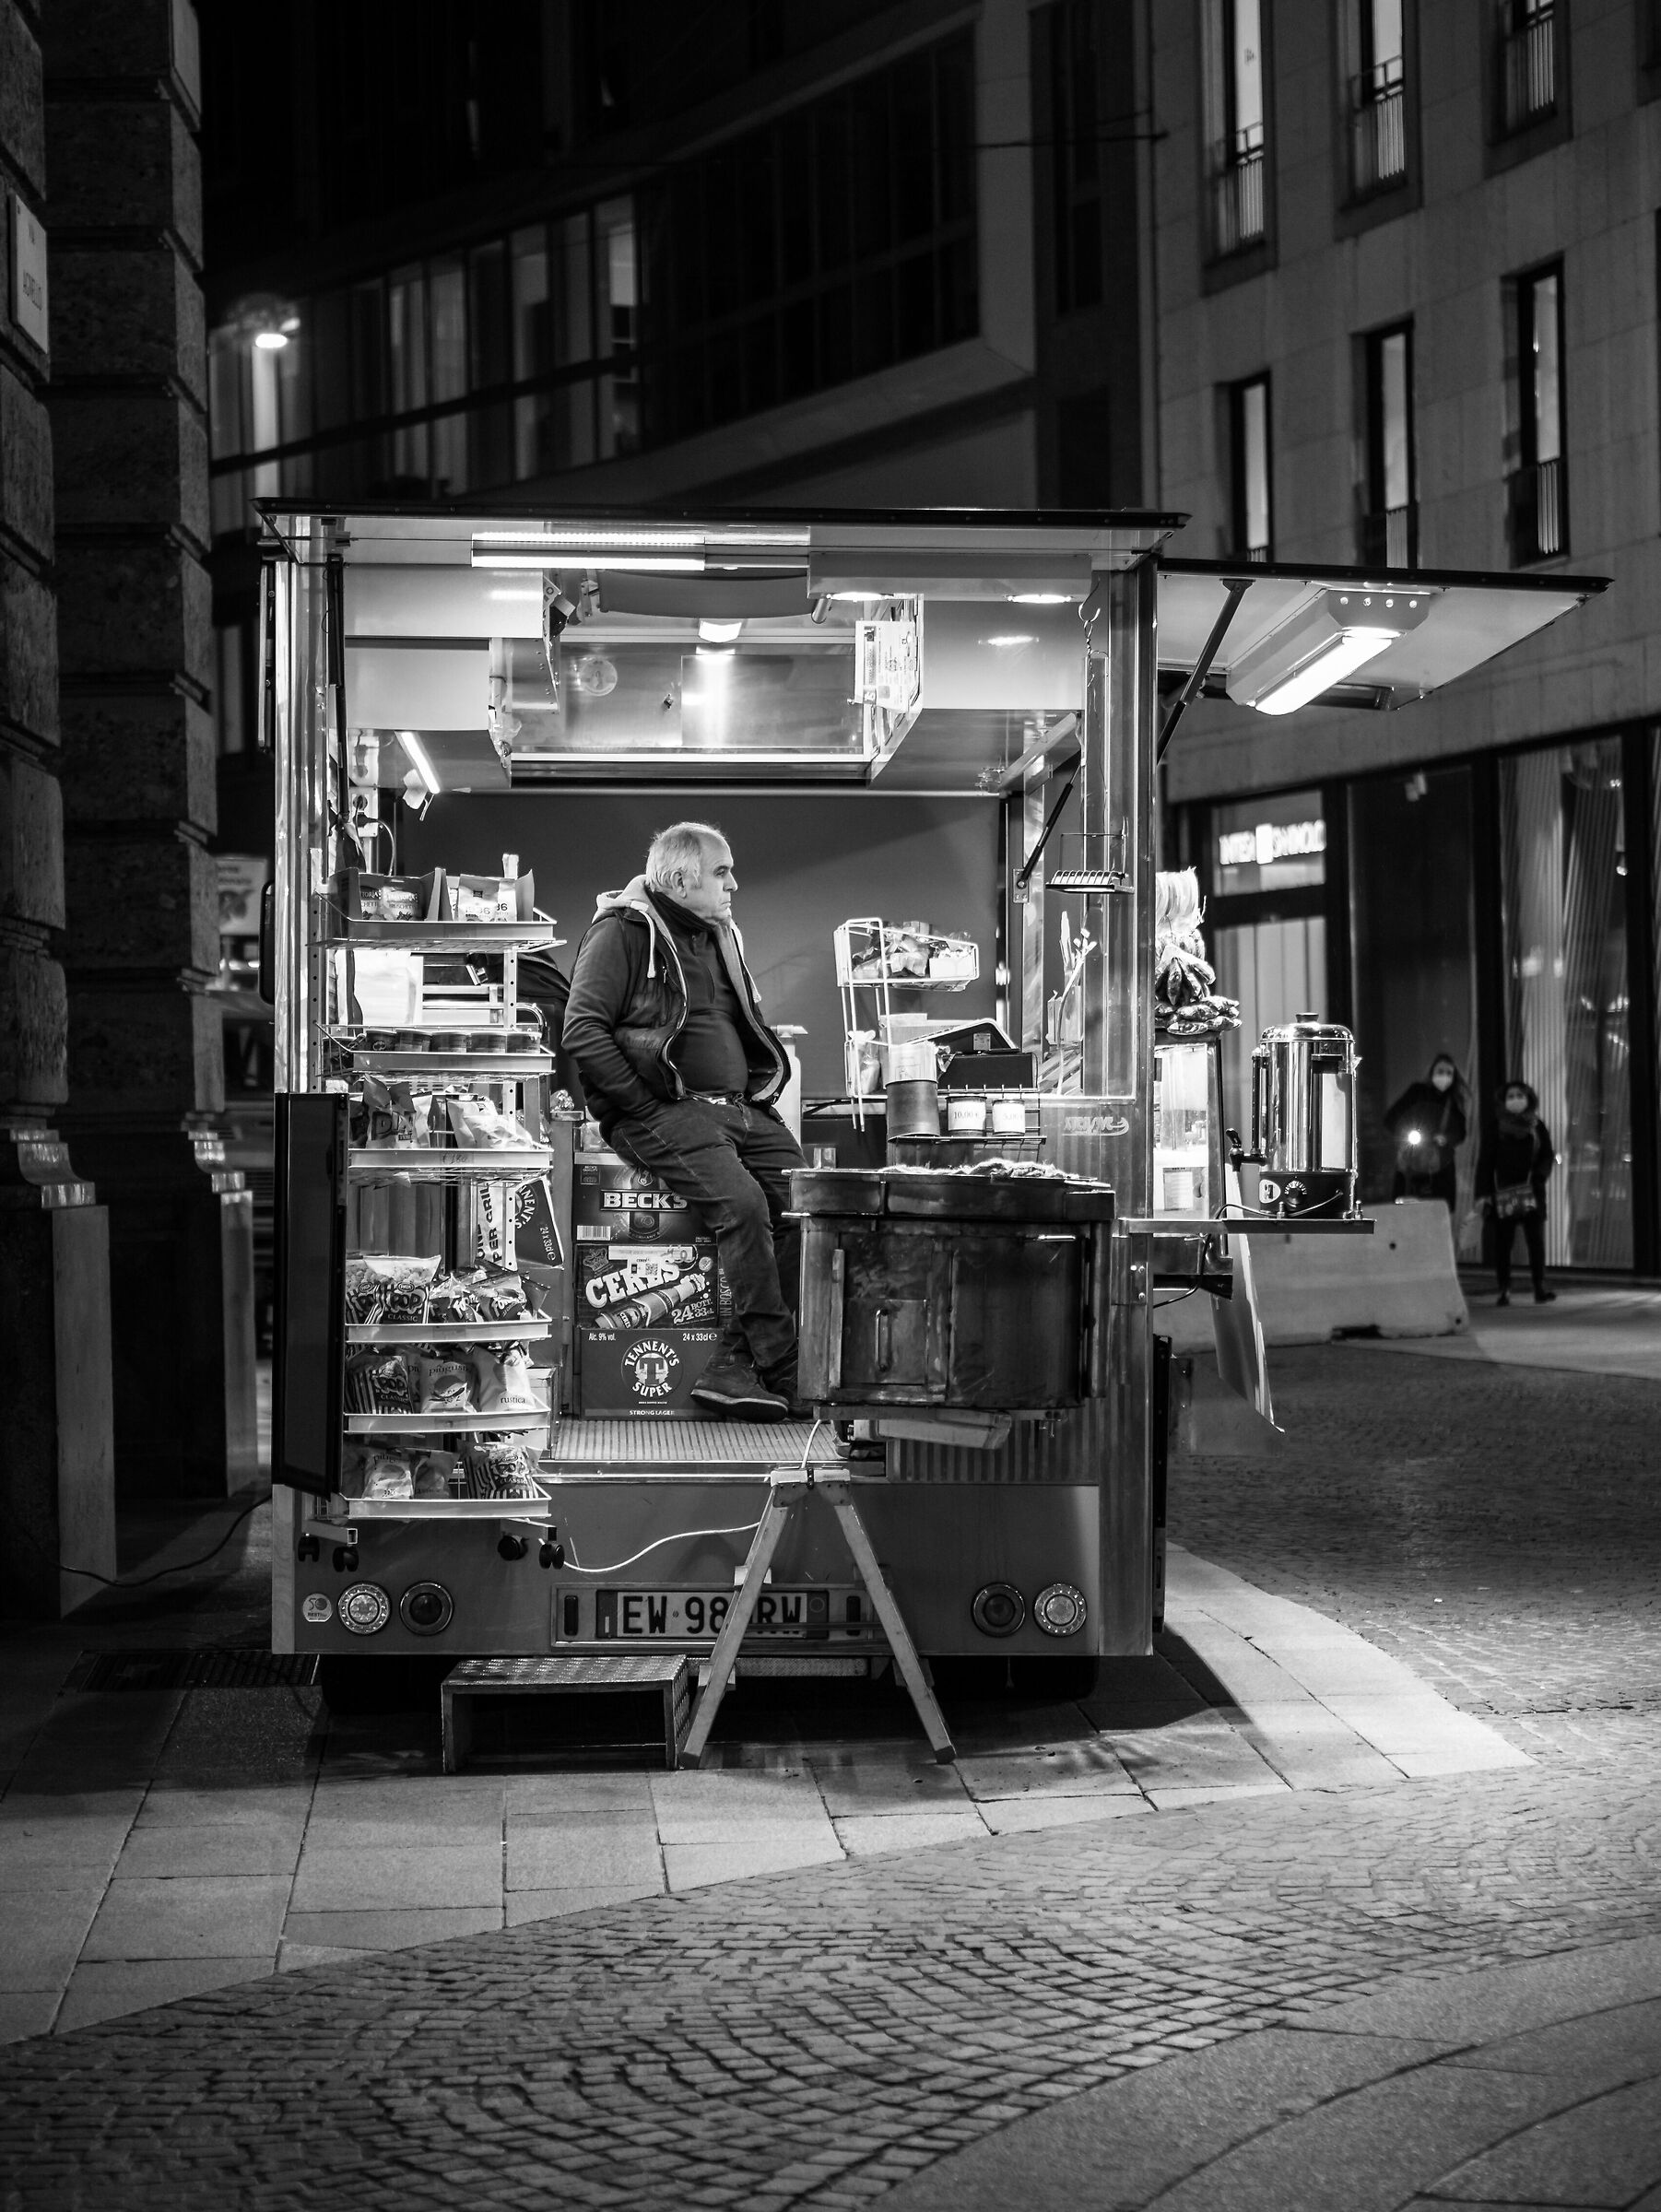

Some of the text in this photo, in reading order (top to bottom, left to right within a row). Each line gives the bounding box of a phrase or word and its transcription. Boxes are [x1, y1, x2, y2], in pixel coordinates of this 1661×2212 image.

[604, 1192, 688, 1209] BECK'S
[388, 1313, 418, 1322] CLASSIC
[671, 1305, 695, 1325] 24
[683, 1333, 690, 1342] 24
[625, 1340, 679, 1367] TENNENT'S
[632, 1381, 673, 1397] SUPER
[501, 1394, 525, 1404] rustica
[623, 1595, 801, 1634] EW 98RW
